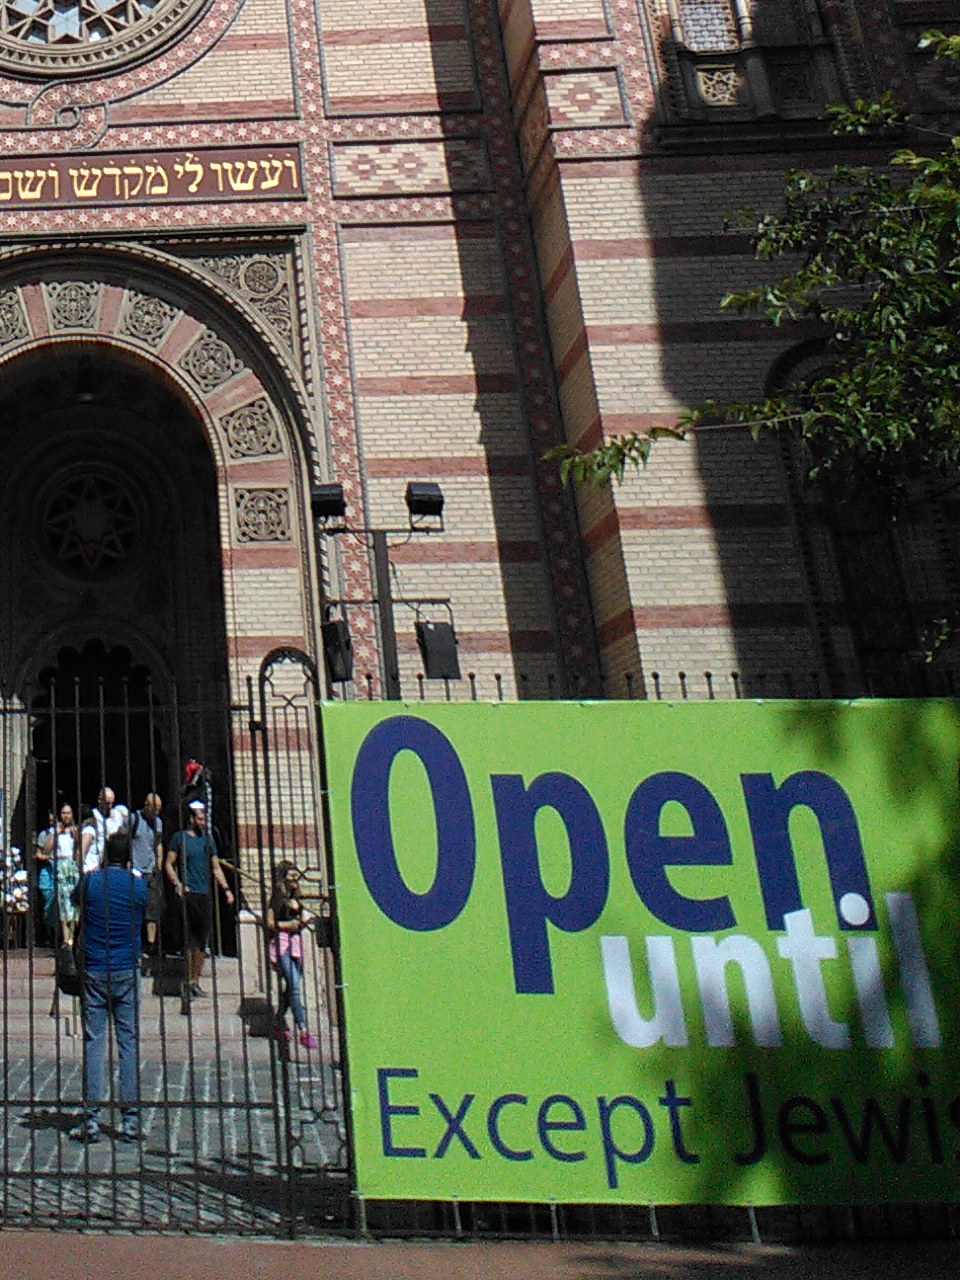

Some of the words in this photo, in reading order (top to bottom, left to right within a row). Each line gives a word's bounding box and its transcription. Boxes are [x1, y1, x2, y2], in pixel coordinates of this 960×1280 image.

[69, 159, 169, 199] מקדש
[173, 153, 204, 193] לי
[209, 154, 299, 192] ועשו
[350, 714, 879, 995] Open
[599, 892, 941, 1050] until
[376, 1067, 701, 1190] Except
